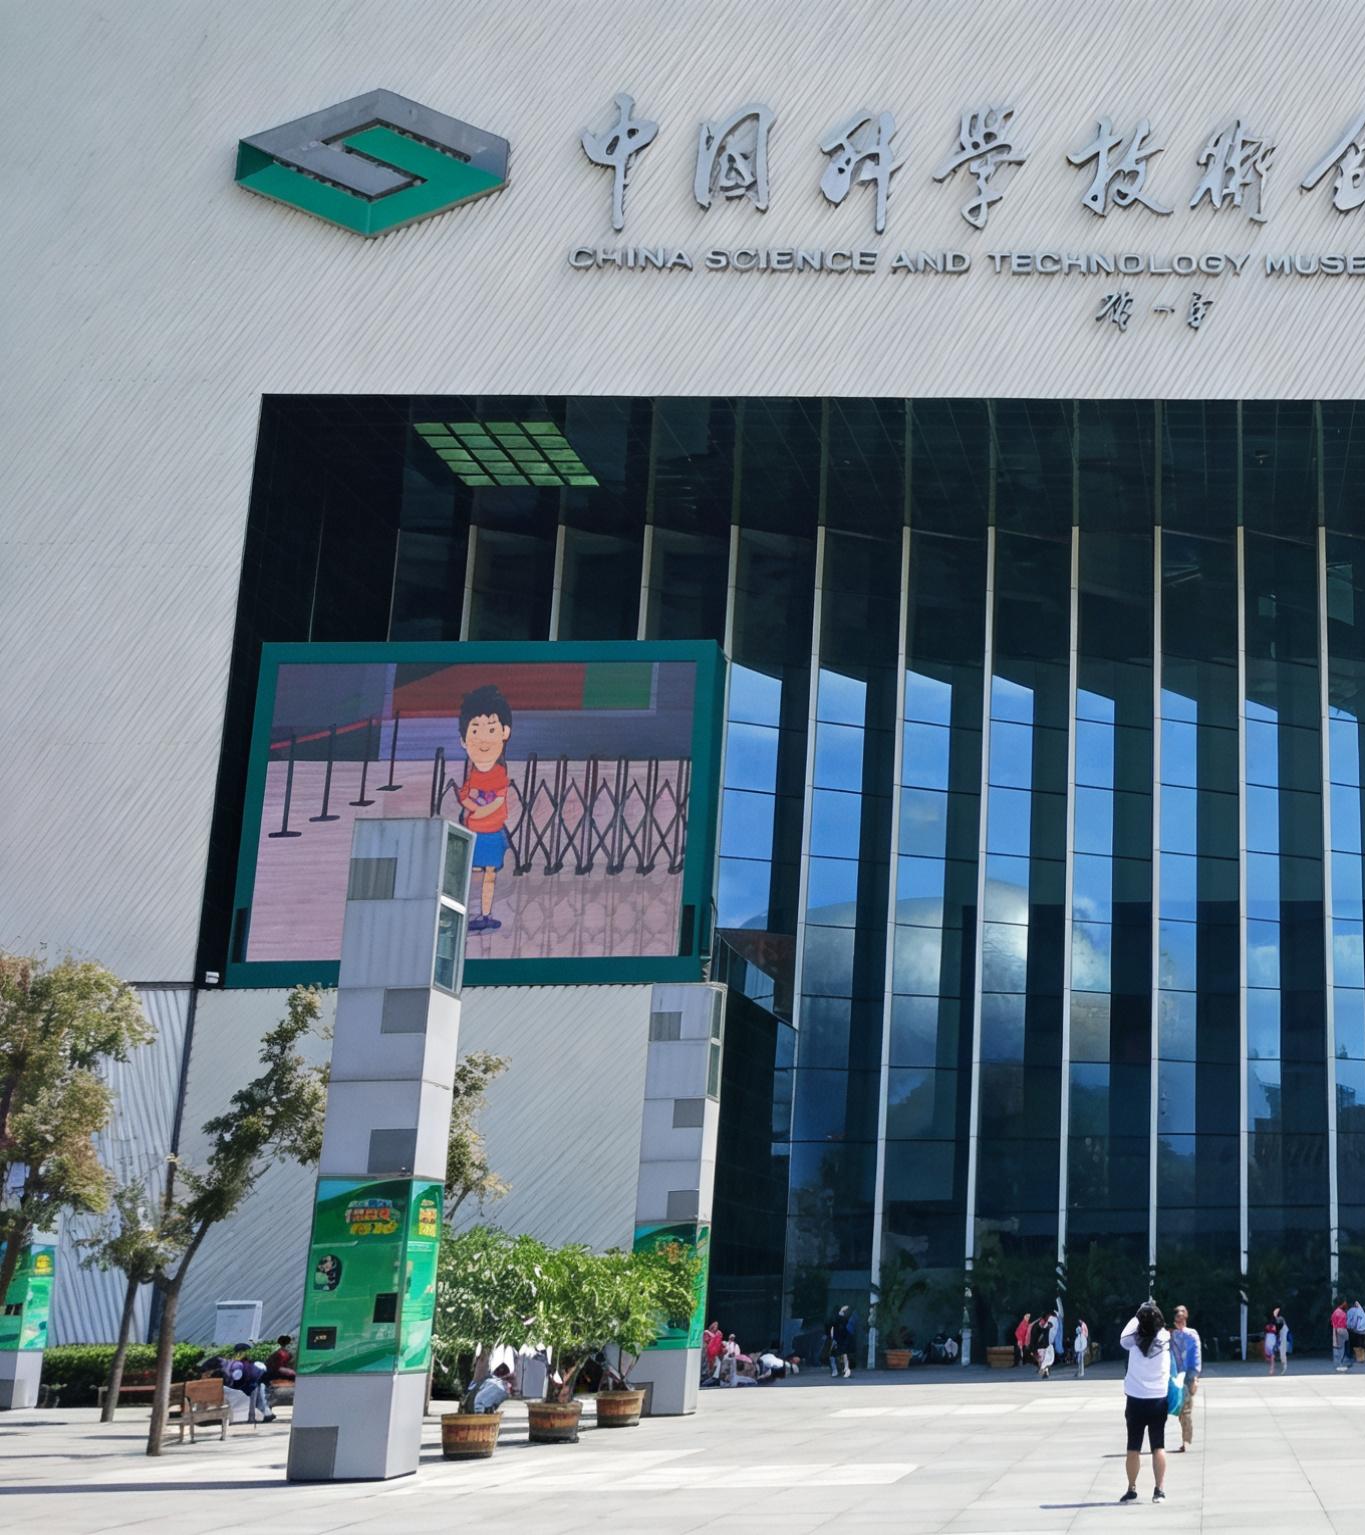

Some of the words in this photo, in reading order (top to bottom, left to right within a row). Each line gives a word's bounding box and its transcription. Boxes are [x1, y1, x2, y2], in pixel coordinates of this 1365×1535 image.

[568, 247, 693, 272] CHINA
[704, 247, 878, 273] SCIENCE
[891, 250, 971, 274] AND
[988, 252, 1250, 276] TECHNOLOGY
